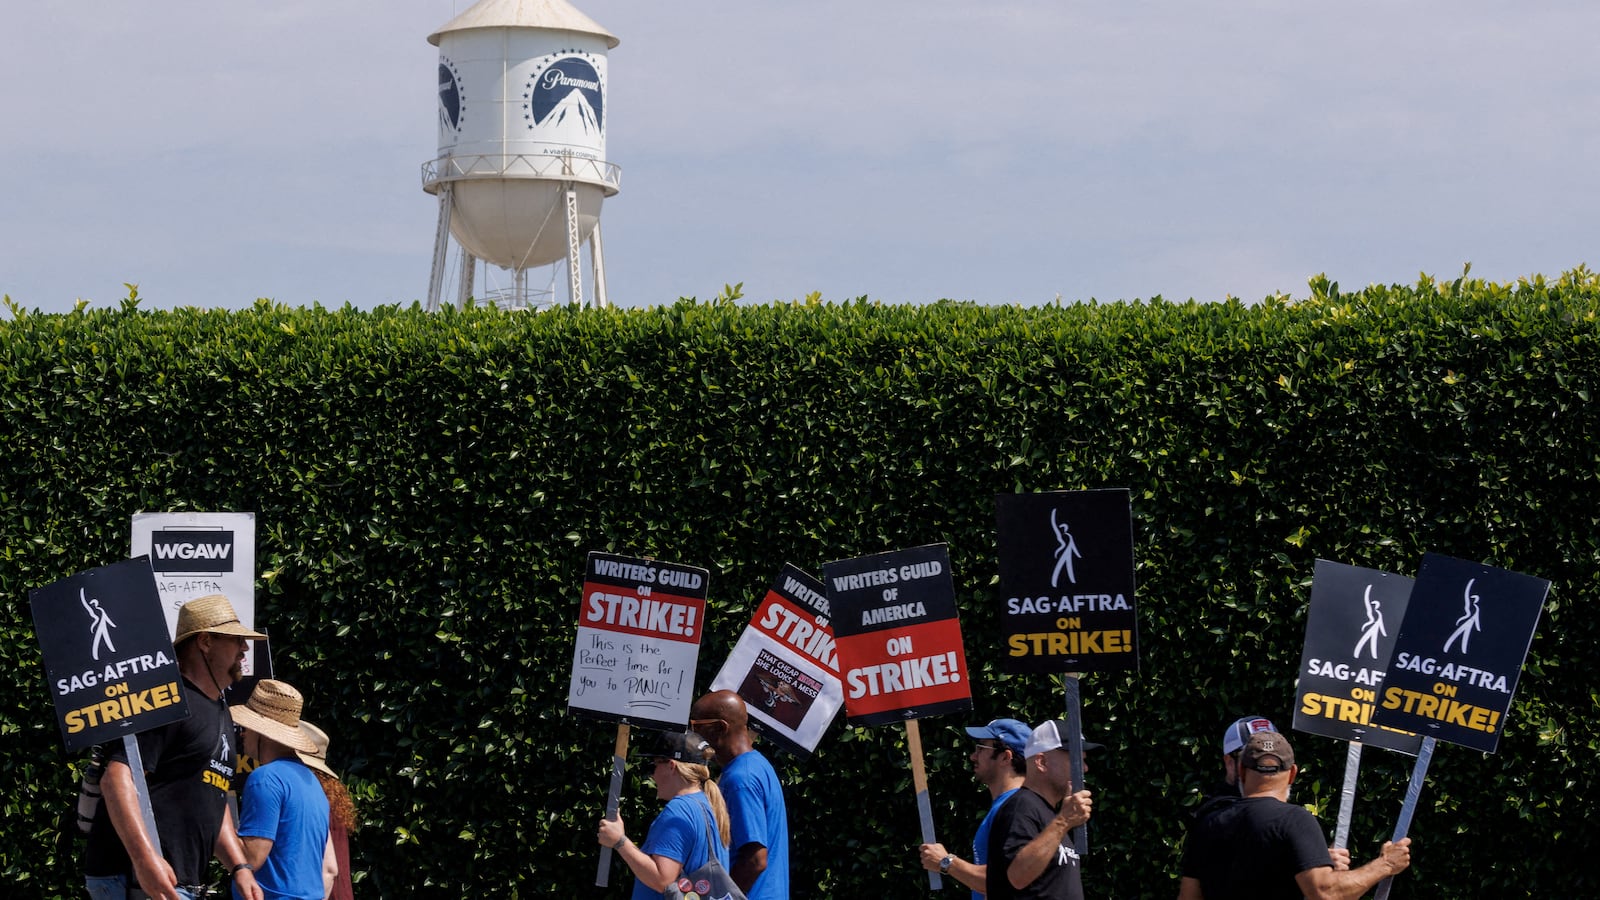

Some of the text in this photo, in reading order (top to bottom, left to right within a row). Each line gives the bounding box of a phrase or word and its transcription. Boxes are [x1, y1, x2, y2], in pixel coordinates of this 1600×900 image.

[542, 69, 600, 92] Paramount
[154, 543, 231, 559] WGAW
[594, 559, 702, 590] WRITERS GUILD
[832, 560, 942, 593] WRITERS GUILD
[159, 581, 223, 593] AG-AFTRA
[637, 585, 652, 597] ON
[783, 575, 832, 618] WRITER
[882, 588, 899, 602] OF
[587, 591, 697, 637] STRIKE!
[815, 615, 829, 628] ON
[861, 601, 927, 626] AMERICA
[1056, 617, 1081, 630] ON
[588, 633, 662, 656] This is the
[886, 636, 913, 657] ON
[1008, 629, 1132, 657] STRIKE!
[625, 657, 649, 672] time
[658, 660, 672, 674] for
[760, 651, 799, 677] THAT CHEAP
[846, 651, 961, 699] STRIKE!
[576, 676, 597, 697] you
[607, 677, 617, 690] to
[756, 658, 771, 671] SHE
[770, 666, 792, 684] LOOKS
[791, 680, 798, 688] A
[798, 684, 818, 698] MESS
[105, 682, 129, 698] ON
[1351, 687, 1376, 702] ON
[1433, 682, 1458, 698] ON
[64, 682, 181, 734] STRIKE!
[1381, 687, 1500, 733] STRIKE!
